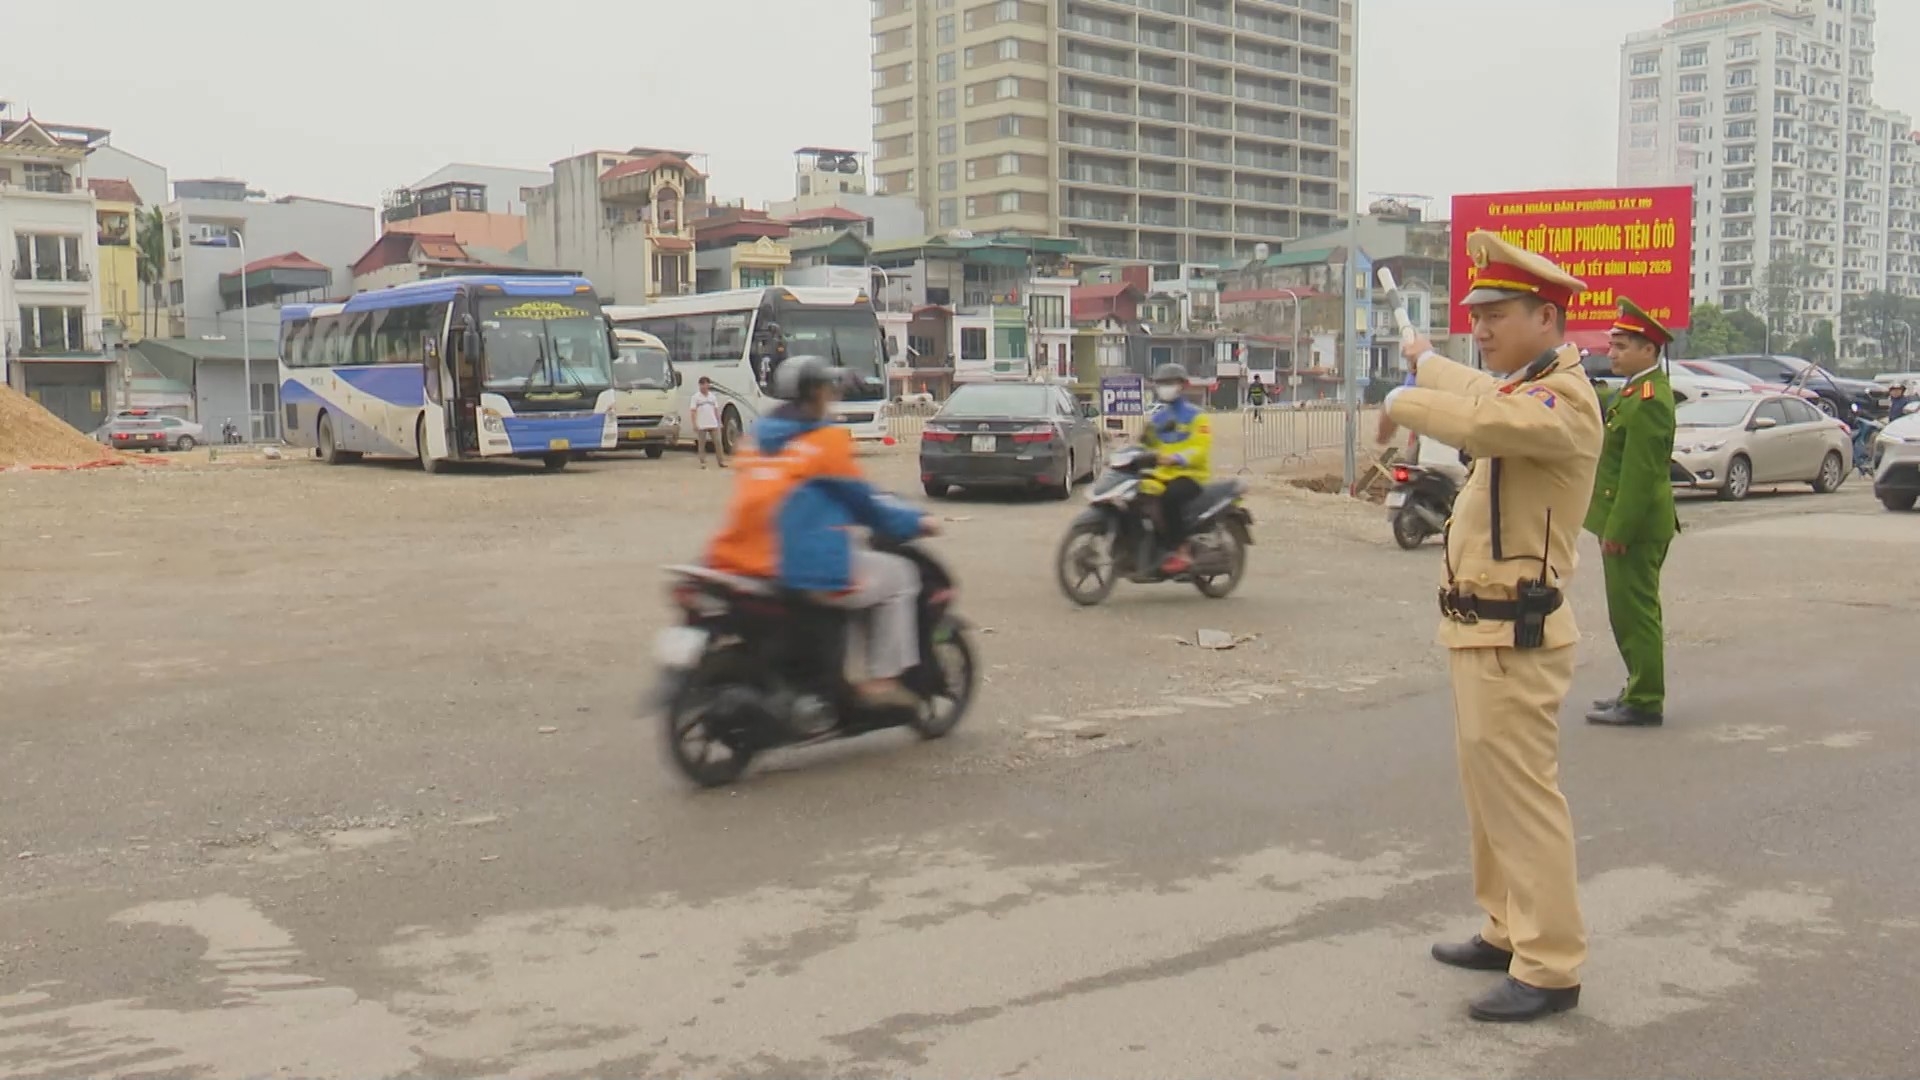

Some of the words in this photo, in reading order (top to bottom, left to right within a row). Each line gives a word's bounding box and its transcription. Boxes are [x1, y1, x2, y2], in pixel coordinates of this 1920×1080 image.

[1526, 223, 1547, 254] GIỮ
[1548, 226, 1573, 258] TẠM
[1624, 219, 1650, 256] TIỆN
[1653, 217, 1675, 249] ÔTÔ
[1579, 287, 1614, 306] PHÍ
[1103, 389, 1116, 412] P
